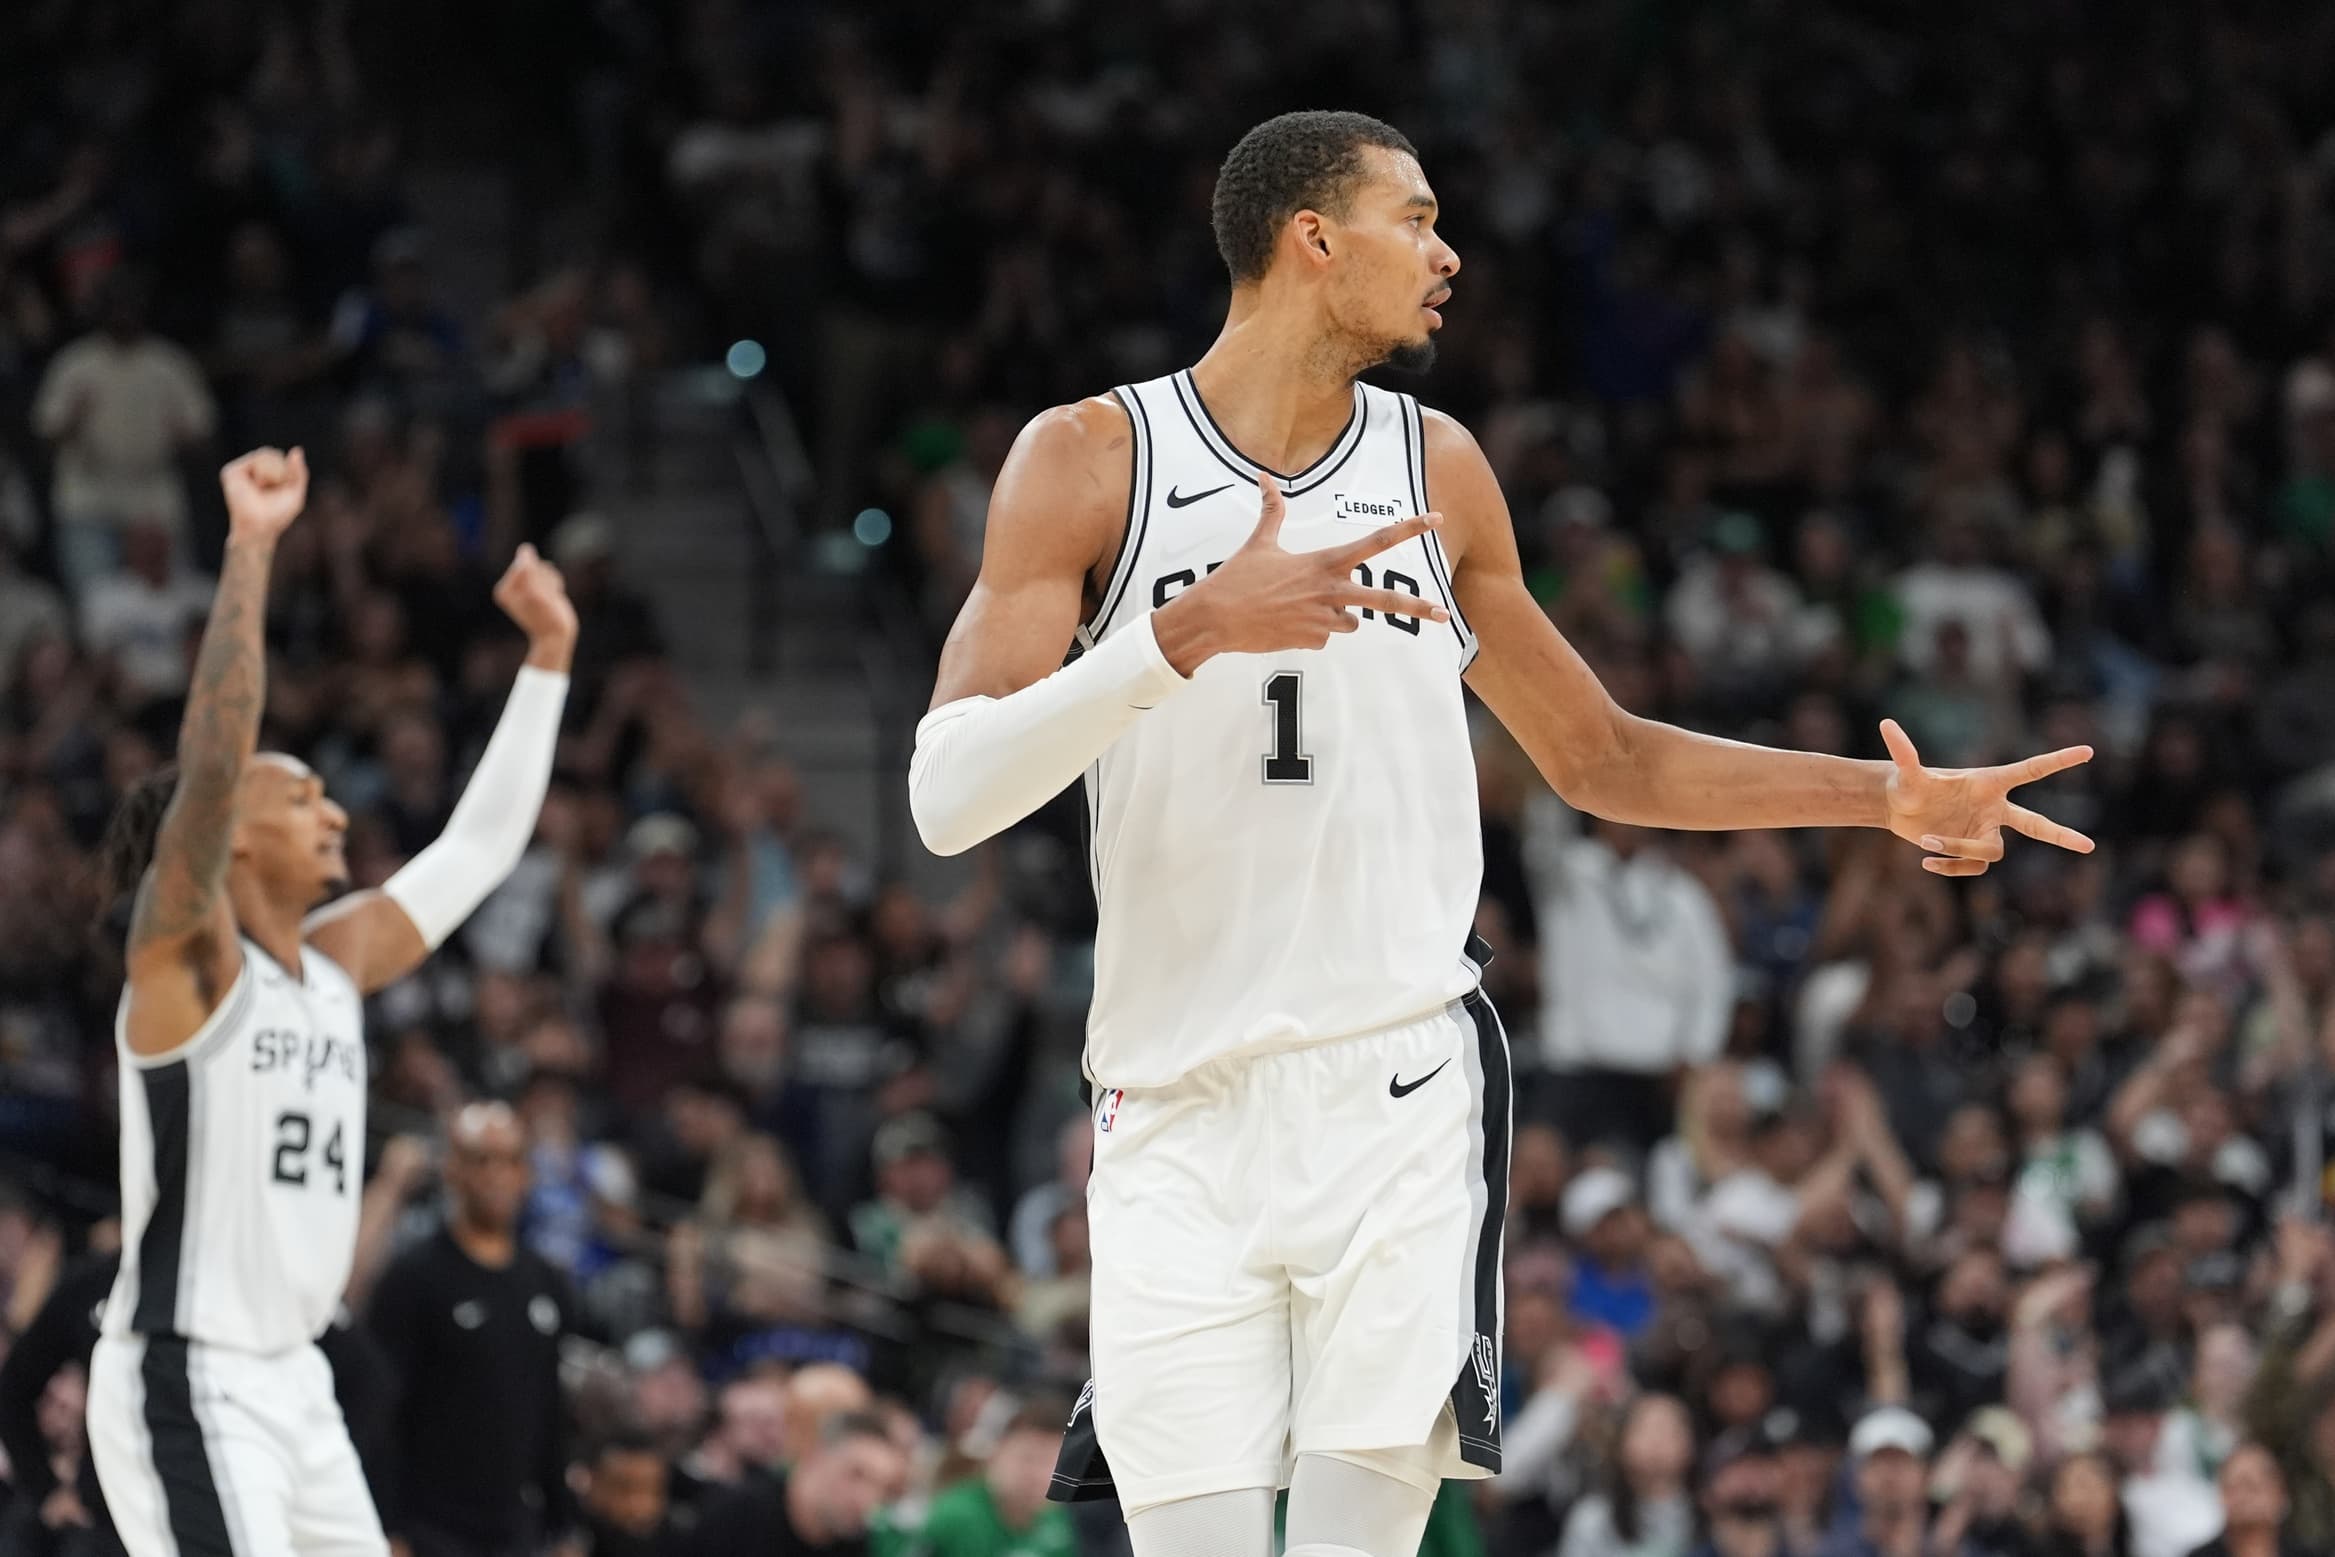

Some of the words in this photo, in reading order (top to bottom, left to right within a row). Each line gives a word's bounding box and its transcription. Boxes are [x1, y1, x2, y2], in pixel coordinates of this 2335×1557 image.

[1345, 501, 1395, 517] LEDGER
[1262, 670, 1314, 785] 1
[271, 1112, 346, 1196] 24
